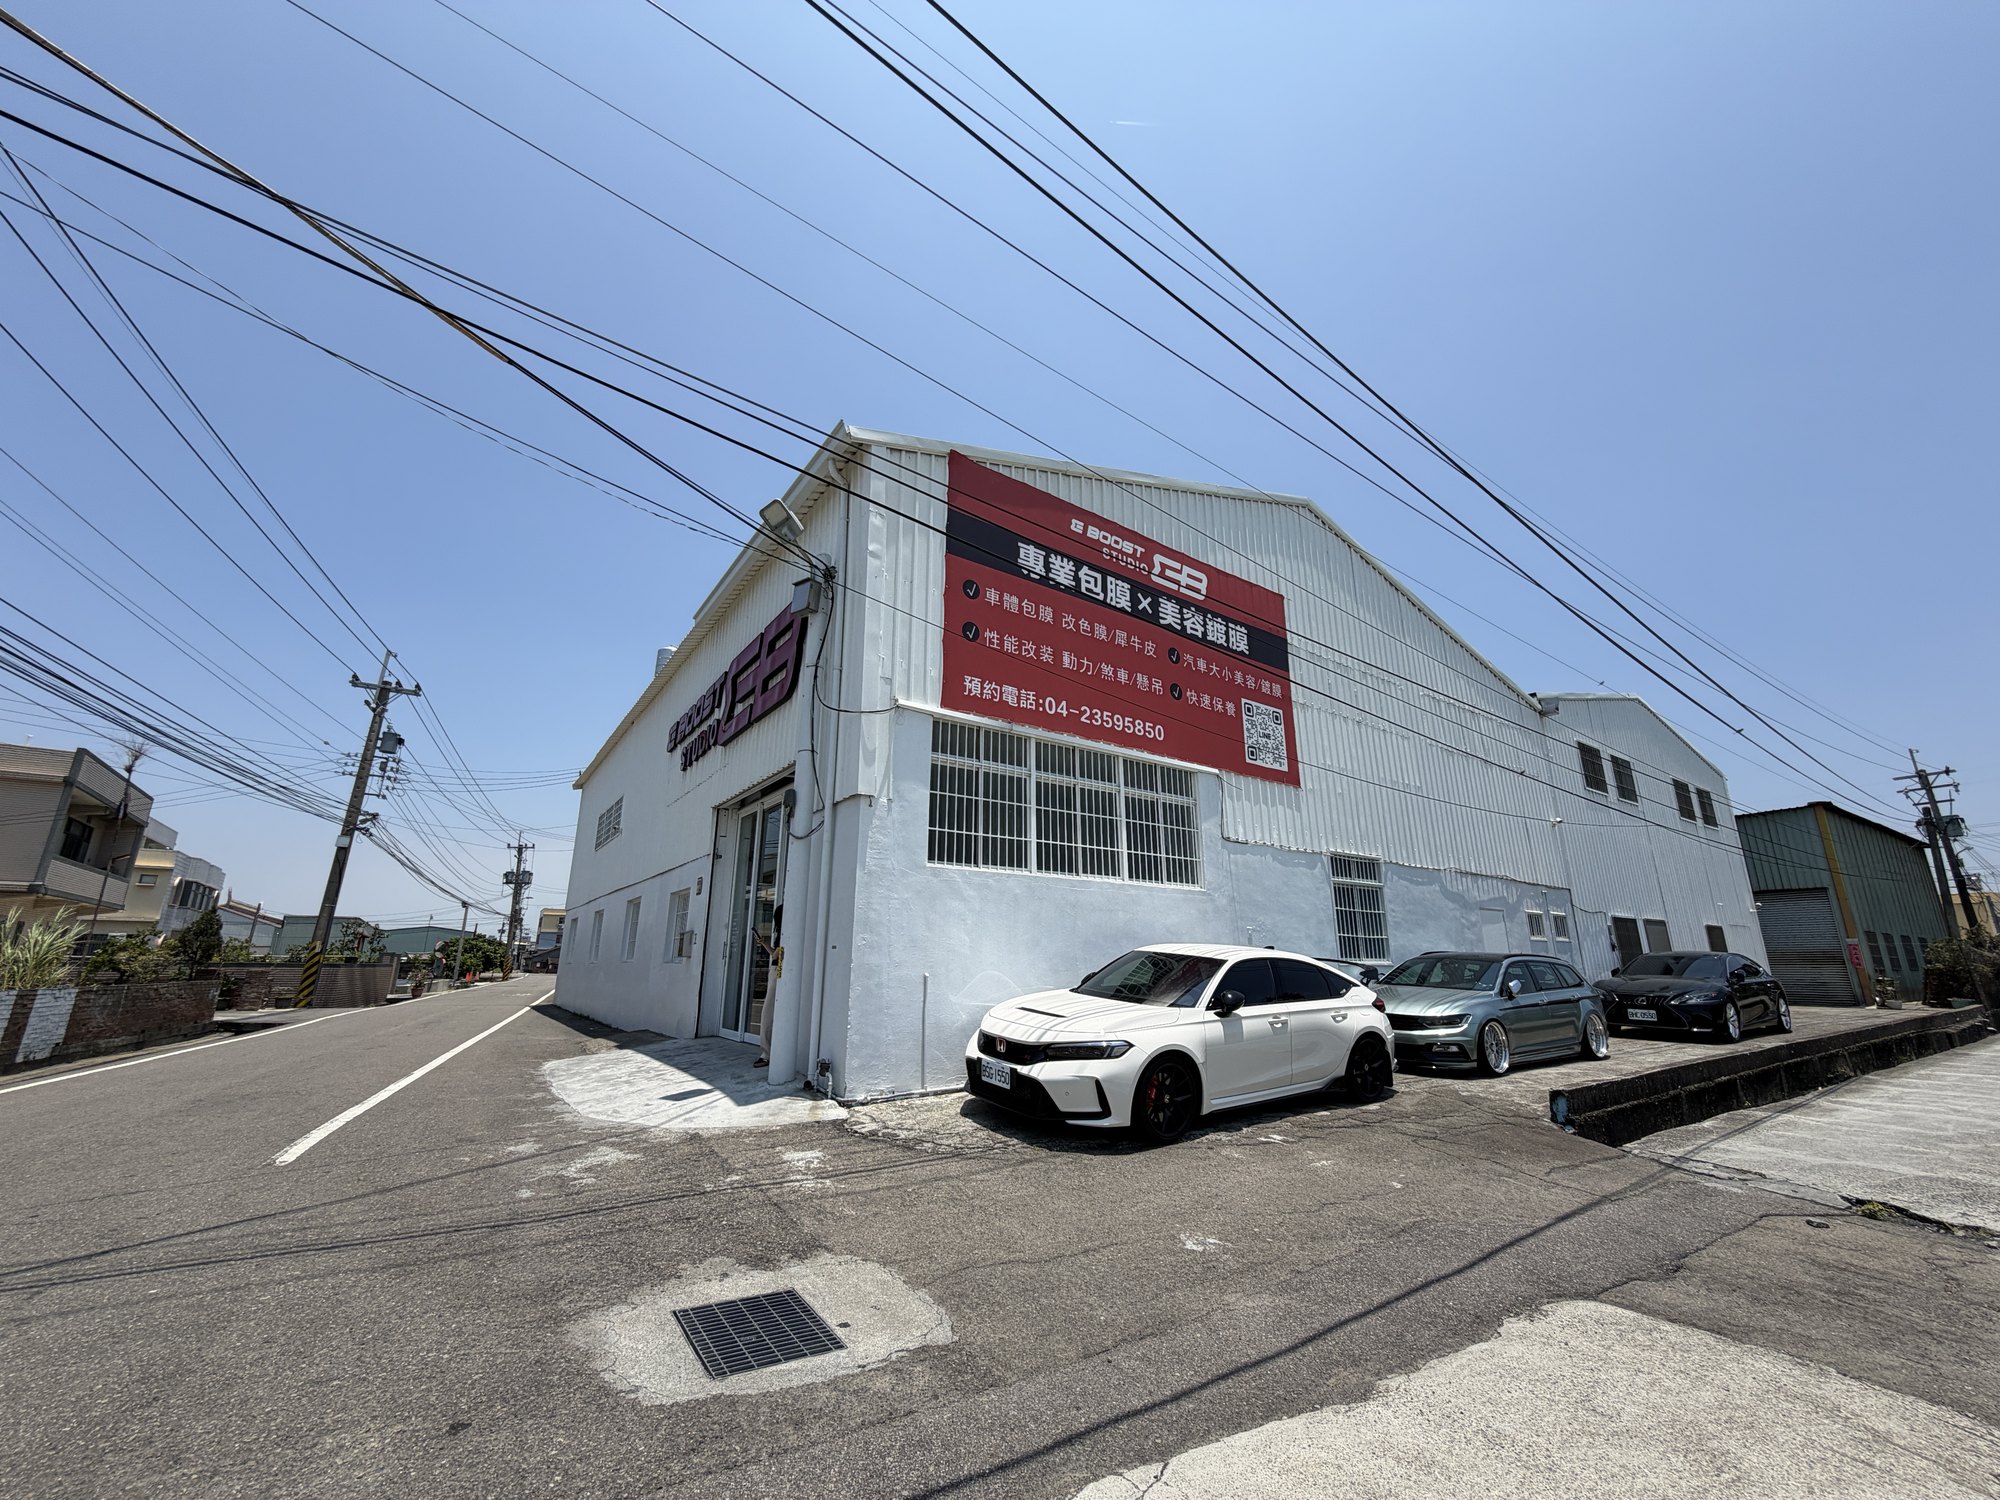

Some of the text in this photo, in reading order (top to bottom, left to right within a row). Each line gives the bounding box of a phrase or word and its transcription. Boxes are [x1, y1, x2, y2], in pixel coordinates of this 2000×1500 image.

[1087, 525, 1146, 558] BOOST
[1102, 547, 1149, 575] STUDIO
[985, 587, 1055, 625] 車體包膜
[1186, 688, 1236, 718] 快速保養
[680, 719, 720, 771] STUDIO
[1258, 730, 1272, 741] LINE
